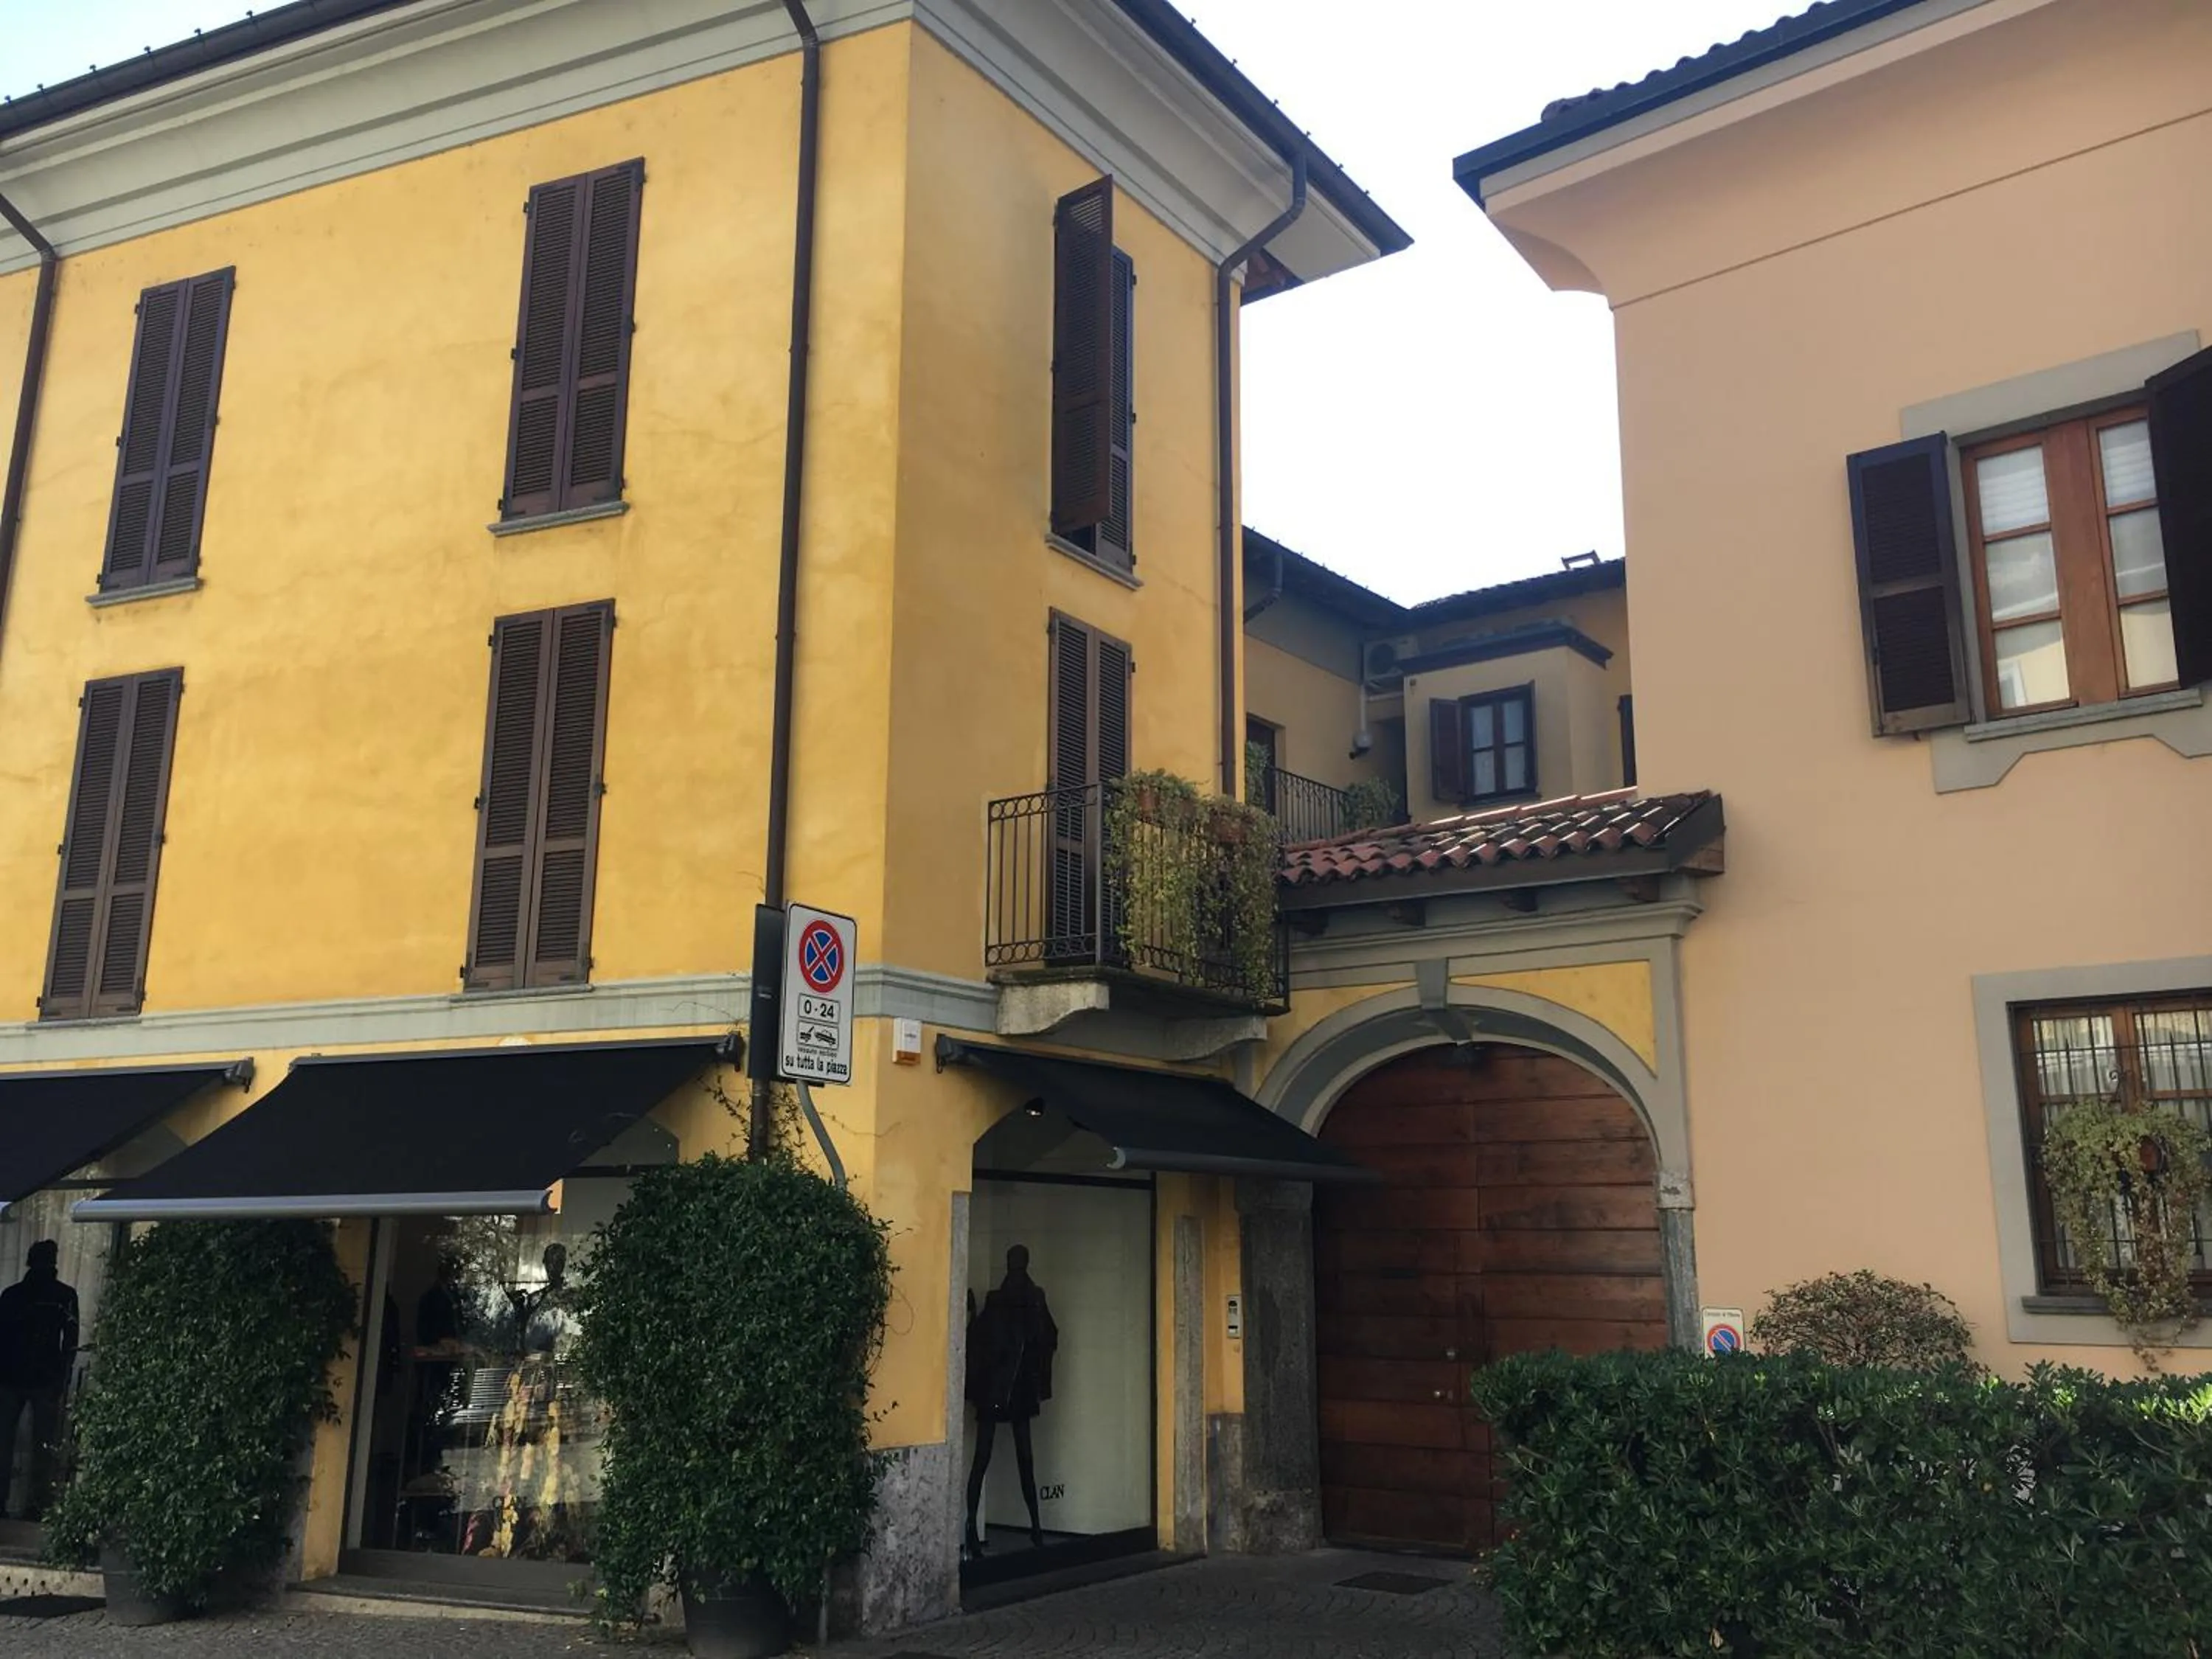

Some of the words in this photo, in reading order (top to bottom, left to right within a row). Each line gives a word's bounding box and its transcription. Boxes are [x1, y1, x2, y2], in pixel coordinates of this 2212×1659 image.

[804, 999, 812, 1015] 0
[820, 1003, 834, 1018] 24
[785, 1055, 794, 1067] su
[798, 1054, 814, 1070] tutta
[817, 1057, 824, 1071] la
[827, 1059, 847, 1075] piazza
[1040, 1484, 1065, 1500] CLAN
